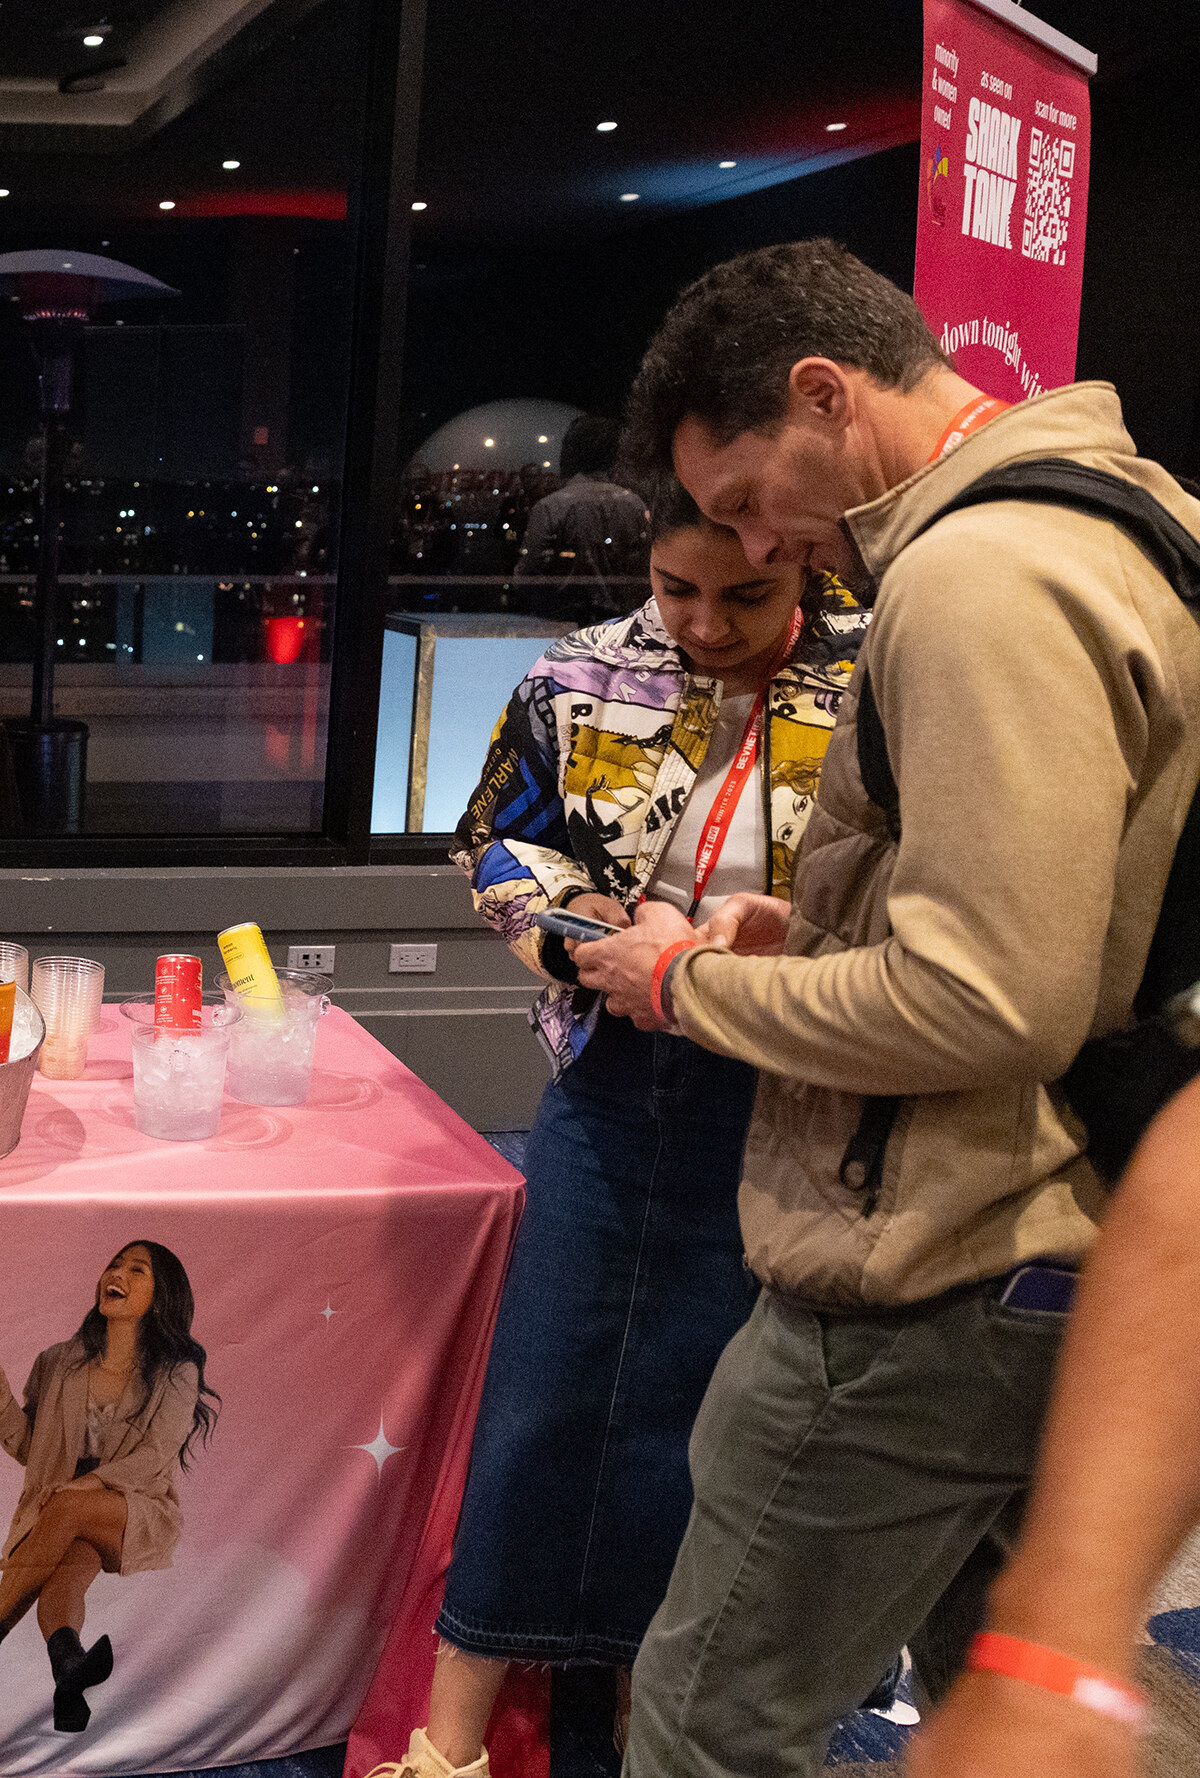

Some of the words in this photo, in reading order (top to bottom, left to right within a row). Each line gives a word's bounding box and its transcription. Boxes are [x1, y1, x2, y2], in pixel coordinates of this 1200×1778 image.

[934, 42, 959, 79] minority
[931, 67, 938, 91] &
[937, 76, 958, 103] women
[980, 70, 989, 89] as
[989, 75, 1004, 96] seen
[1004, 84, 1013, 101] on
[933, 105, 952, 130] owned
[1035, 99, 1049, 120] scan
[1048, 102, 1060, 124] for
[1059, 111, 1077, 131] more
[965, 96, 1022, 180] SHARK
[961, 163, 1017, 250] TANK
[940, 319, 979, 355] down
[982, 315, 1022, 374] tonight
[1020, 361, 1049, 399] wi
[696, 842, 714, 883] BEVNET
[707, 825, 720, 843] LIVE
[714, 797, 729, 823] WINTER
[736, 728, 758, 770] BEVNET
